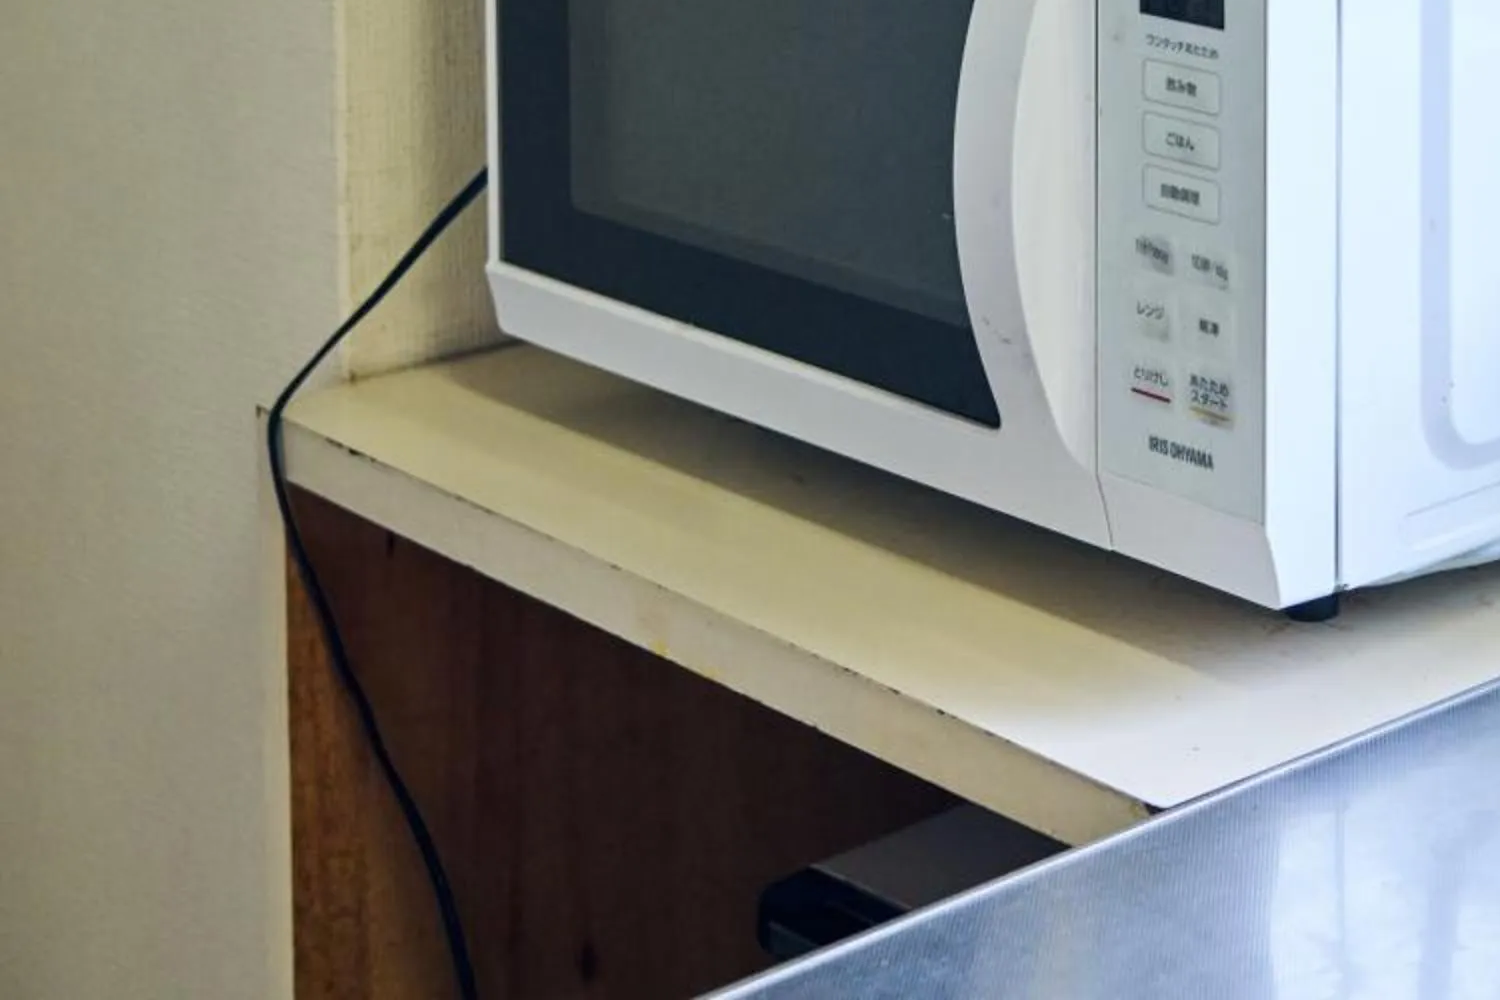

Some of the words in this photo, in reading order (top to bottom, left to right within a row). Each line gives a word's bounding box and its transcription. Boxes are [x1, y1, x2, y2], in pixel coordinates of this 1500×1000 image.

[1165, 131, 1195, 151] ごはん
[1136, 299, 1166, 320] レンジ
[1133, 366, 1170, 388] とりけし
[1190, 388, 1229, 411] スタート
[1148, 434, 1169, 457] IRIS
[1169, 440, 1215, 471] OHYAMA
